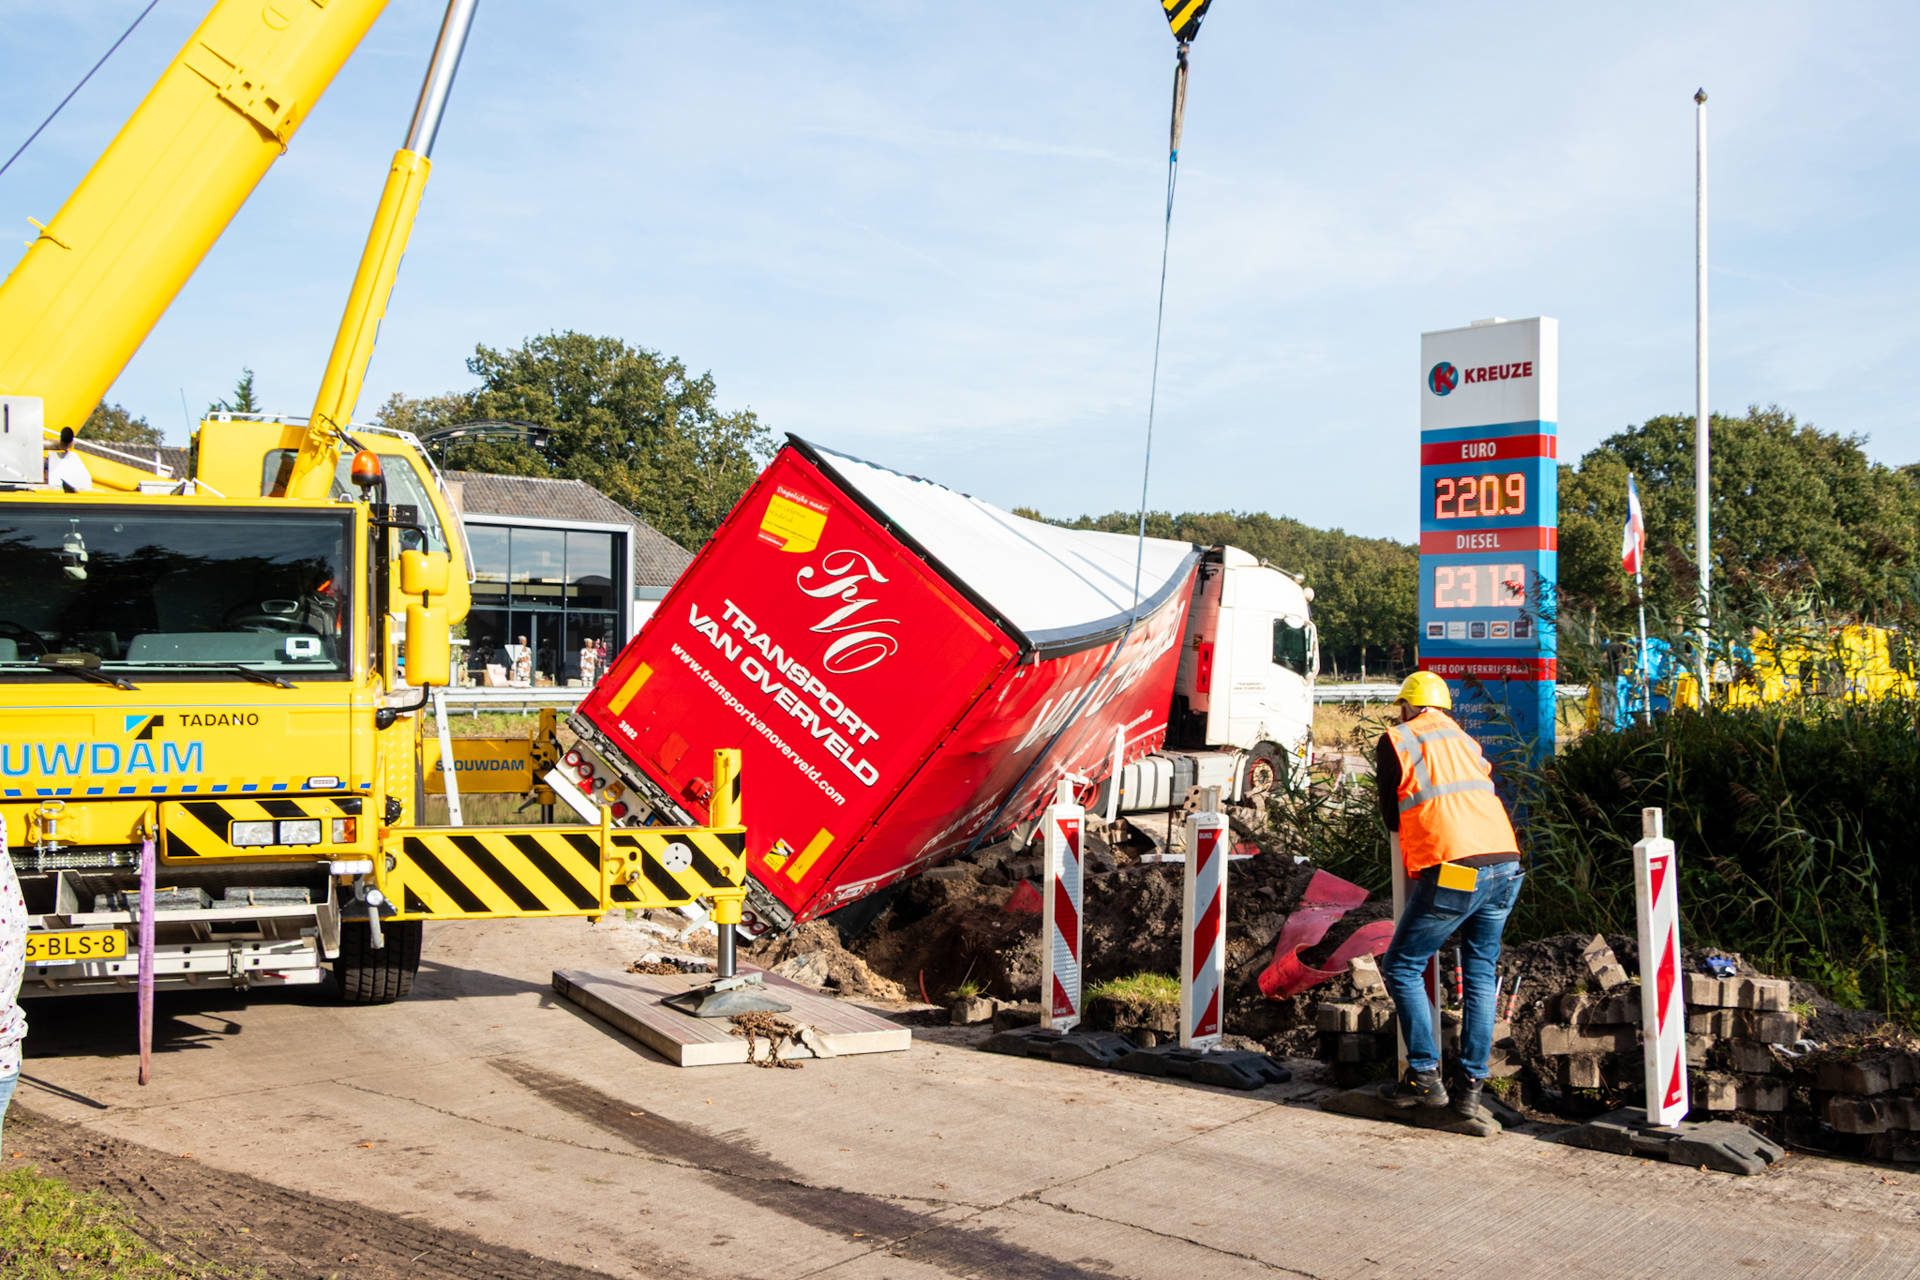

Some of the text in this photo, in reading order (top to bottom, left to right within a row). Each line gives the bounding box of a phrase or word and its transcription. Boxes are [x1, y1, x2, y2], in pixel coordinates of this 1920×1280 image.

[1464, 361, 1533, 384] KREUZE
[1461, 441, 1497, 459] EURO
[1436, 472, 1526, 519] 220.9
[1456, 532, 1500, 549] DIESEL
[721, 598, 880, 745] TRANSPORT
[1428, 664, 1447, 674] HIER
[688, 602, 880, 787] VAN OVERVELD
[180, 713, 260, 727] TADANO
[618, 718, 639, 740] 3002
[670, 642, 847, 807] www.transportvanoverveld.com
[0, 741, 204, 776] UWDAM
[435, 759, 525, 771] SOUWDAM
